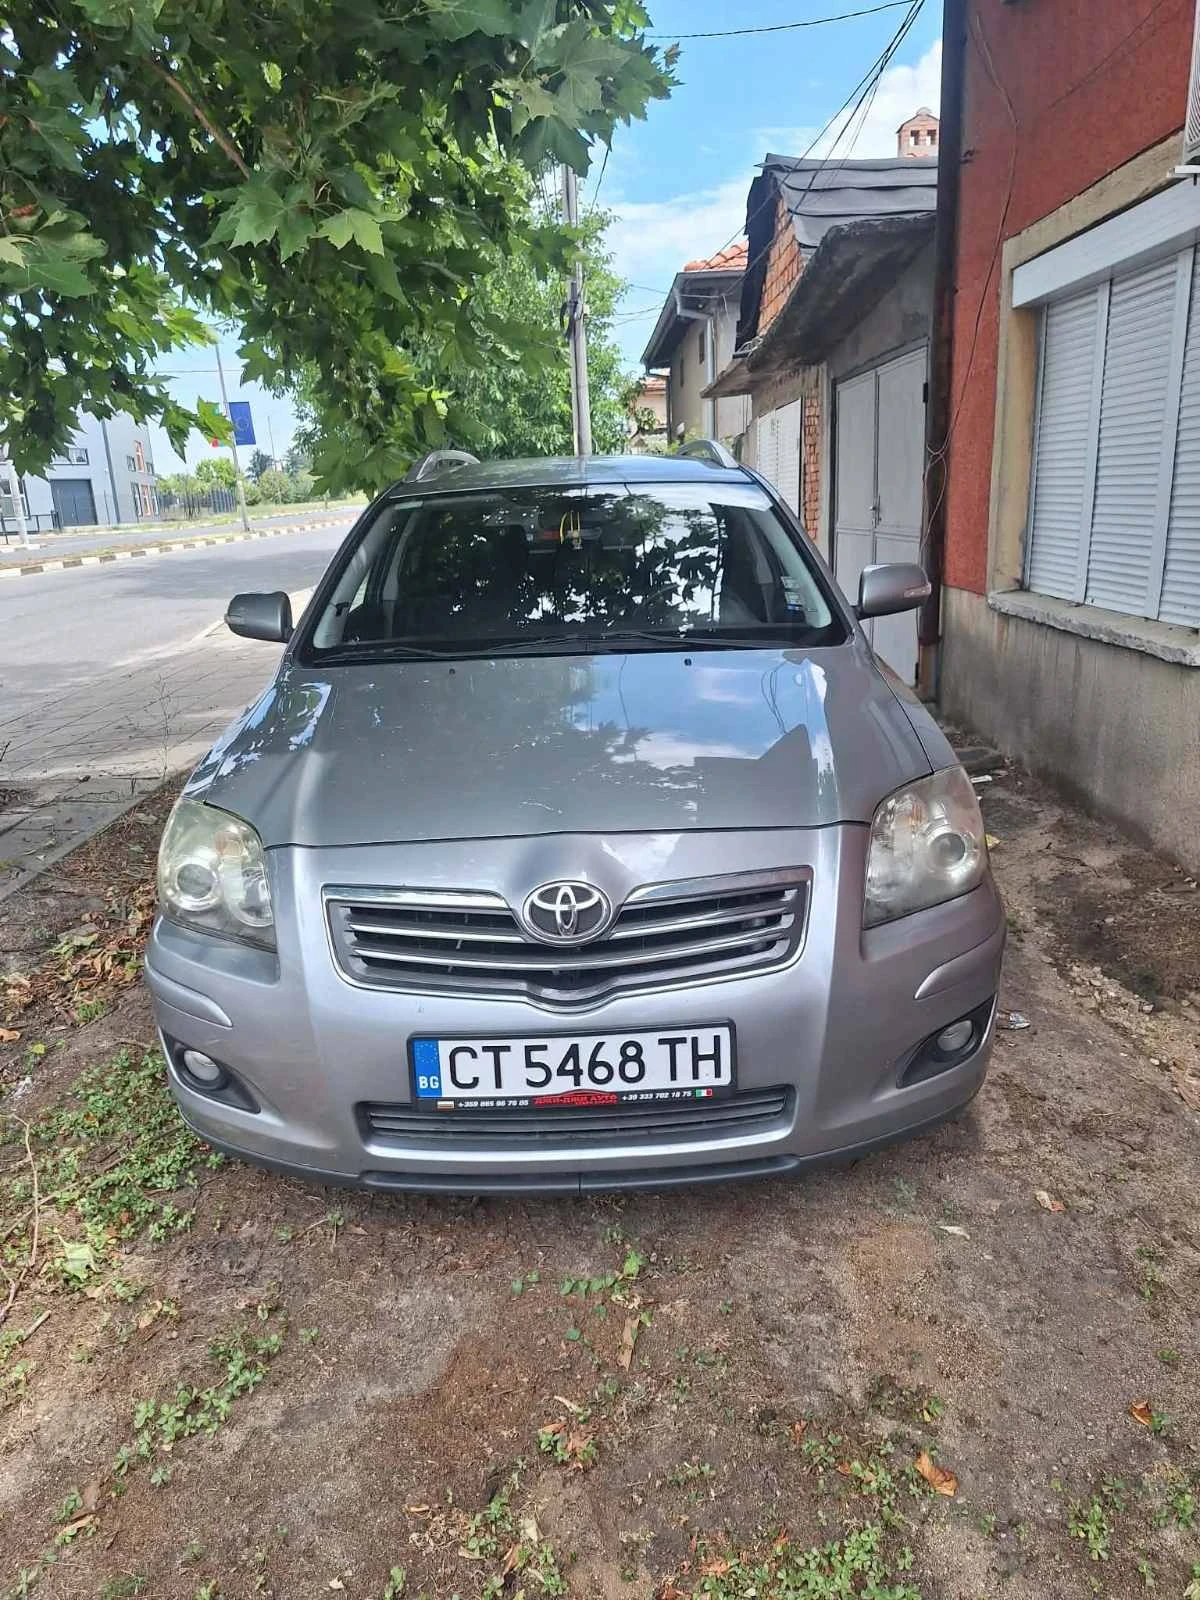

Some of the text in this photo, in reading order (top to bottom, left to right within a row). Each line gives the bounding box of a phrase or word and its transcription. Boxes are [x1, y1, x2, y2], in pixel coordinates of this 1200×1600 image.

[449, 1035, 722, 1090] CT 5468 TH
[419, 1075, 439, 1089] BG
